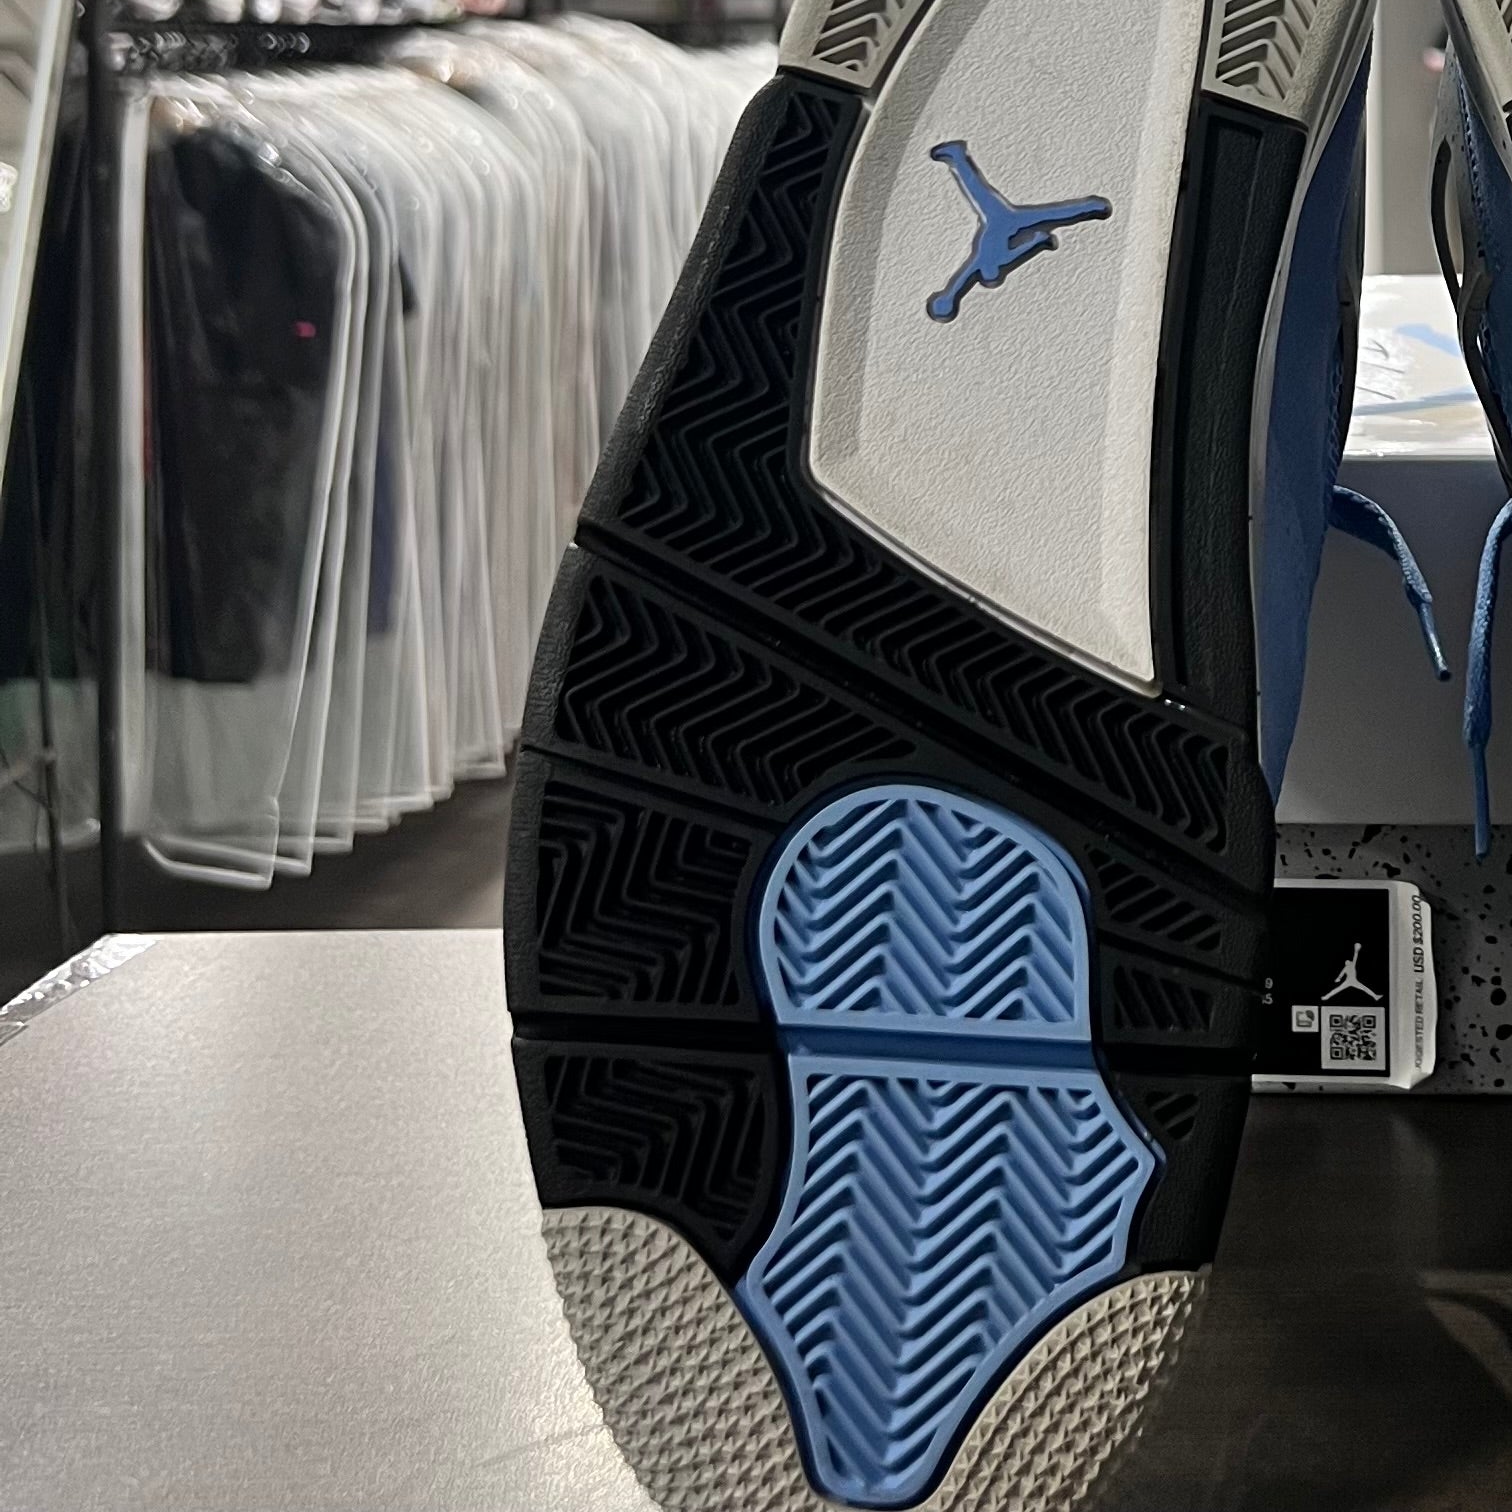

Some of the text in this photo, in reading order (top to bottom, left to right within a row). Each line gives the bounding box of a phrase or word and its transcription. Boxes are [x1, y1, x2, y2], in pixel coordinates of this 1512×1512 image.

[1411, 895, 1423, 945] $200.00
[1412, 947, 1424, 973] USD
[1415, 981, 1424, 1014] RETAIL
